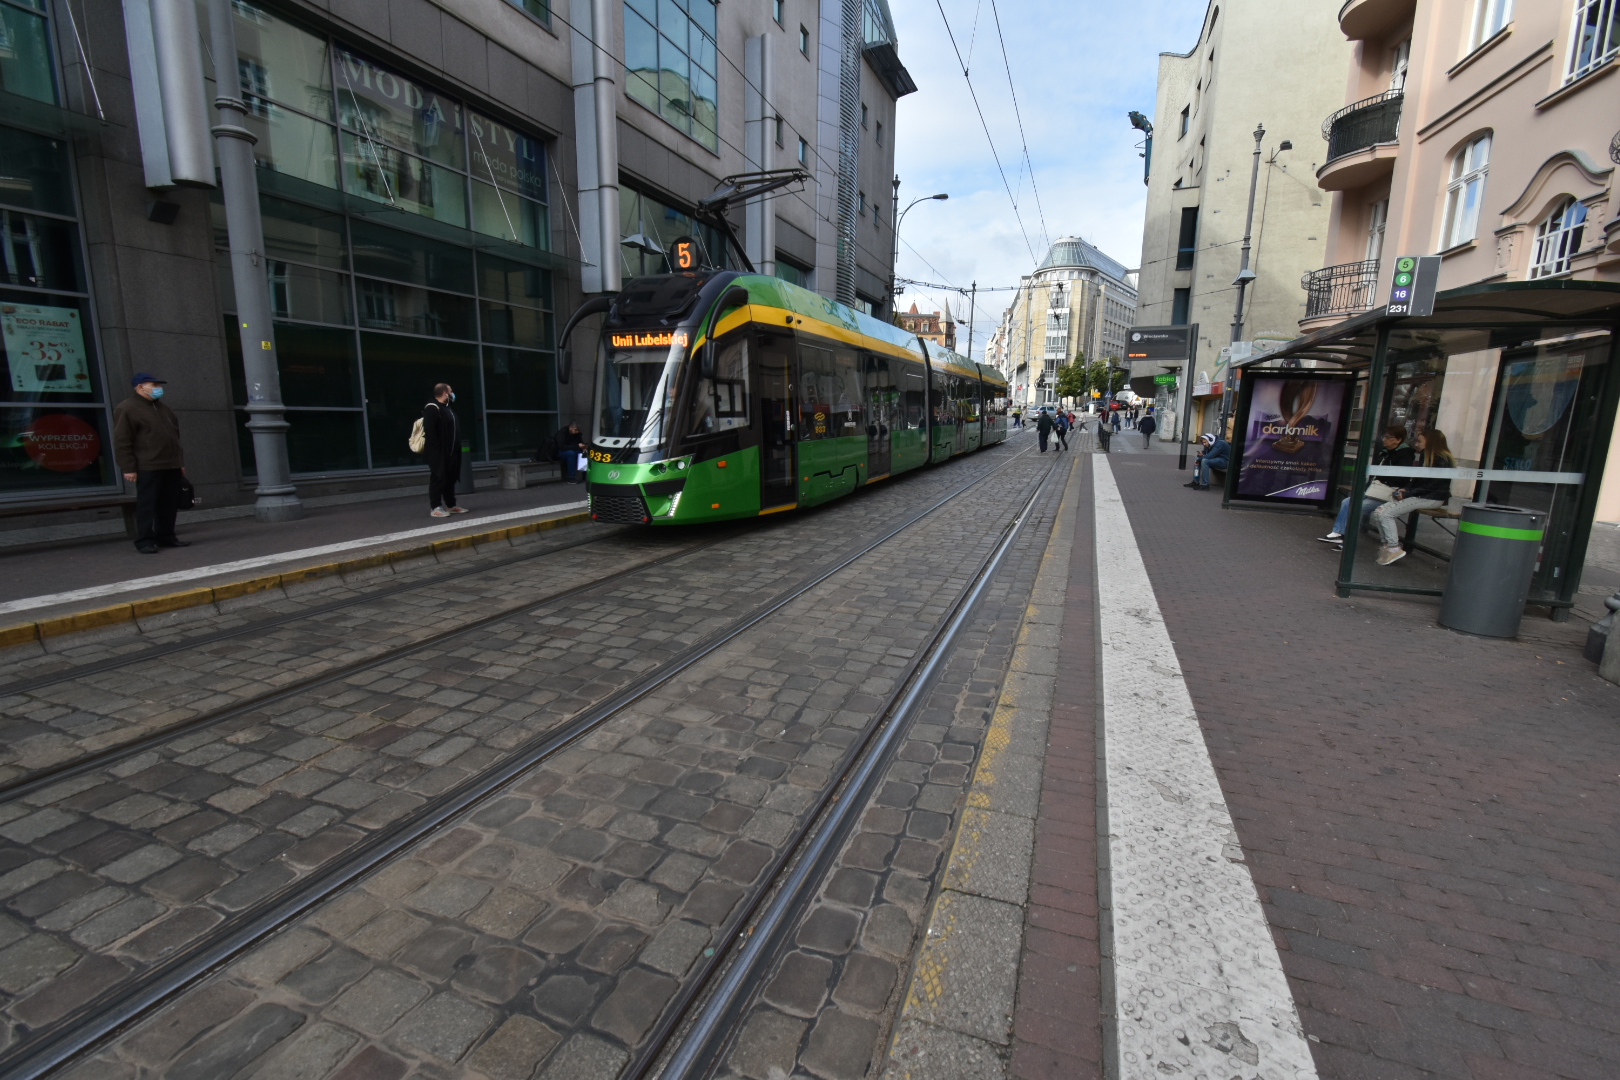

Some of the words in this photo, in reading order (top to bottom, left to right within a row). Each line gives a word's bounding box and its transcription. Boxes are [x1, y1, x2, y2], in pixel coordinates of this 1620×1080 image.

[342, 52, 446, 123] MODA
[454, 104, 463, 129] i
[469, 113, 535, 162] STYL
[474, 151, 507, 173] moda
[510, 166, 541, 187] polska
[678, 243, 691, 268] 5
[1400, 275, 1407, 283] 6
[1395, 290, 1406, 298] 16
[1389, 305, 1407, 313] 231
[612, 334, 633, 347] Unii
[635, 332, 688, 347] Lubelskiej
[21, 341, 75, 361] -35%
[30, 433, 94, 441] WYPRZEDAŻ
[1262, 423, 1319, 437] darkmilk
[589, 449, 612, 463] 933
[1295, 485, 1320, 496] Milka
